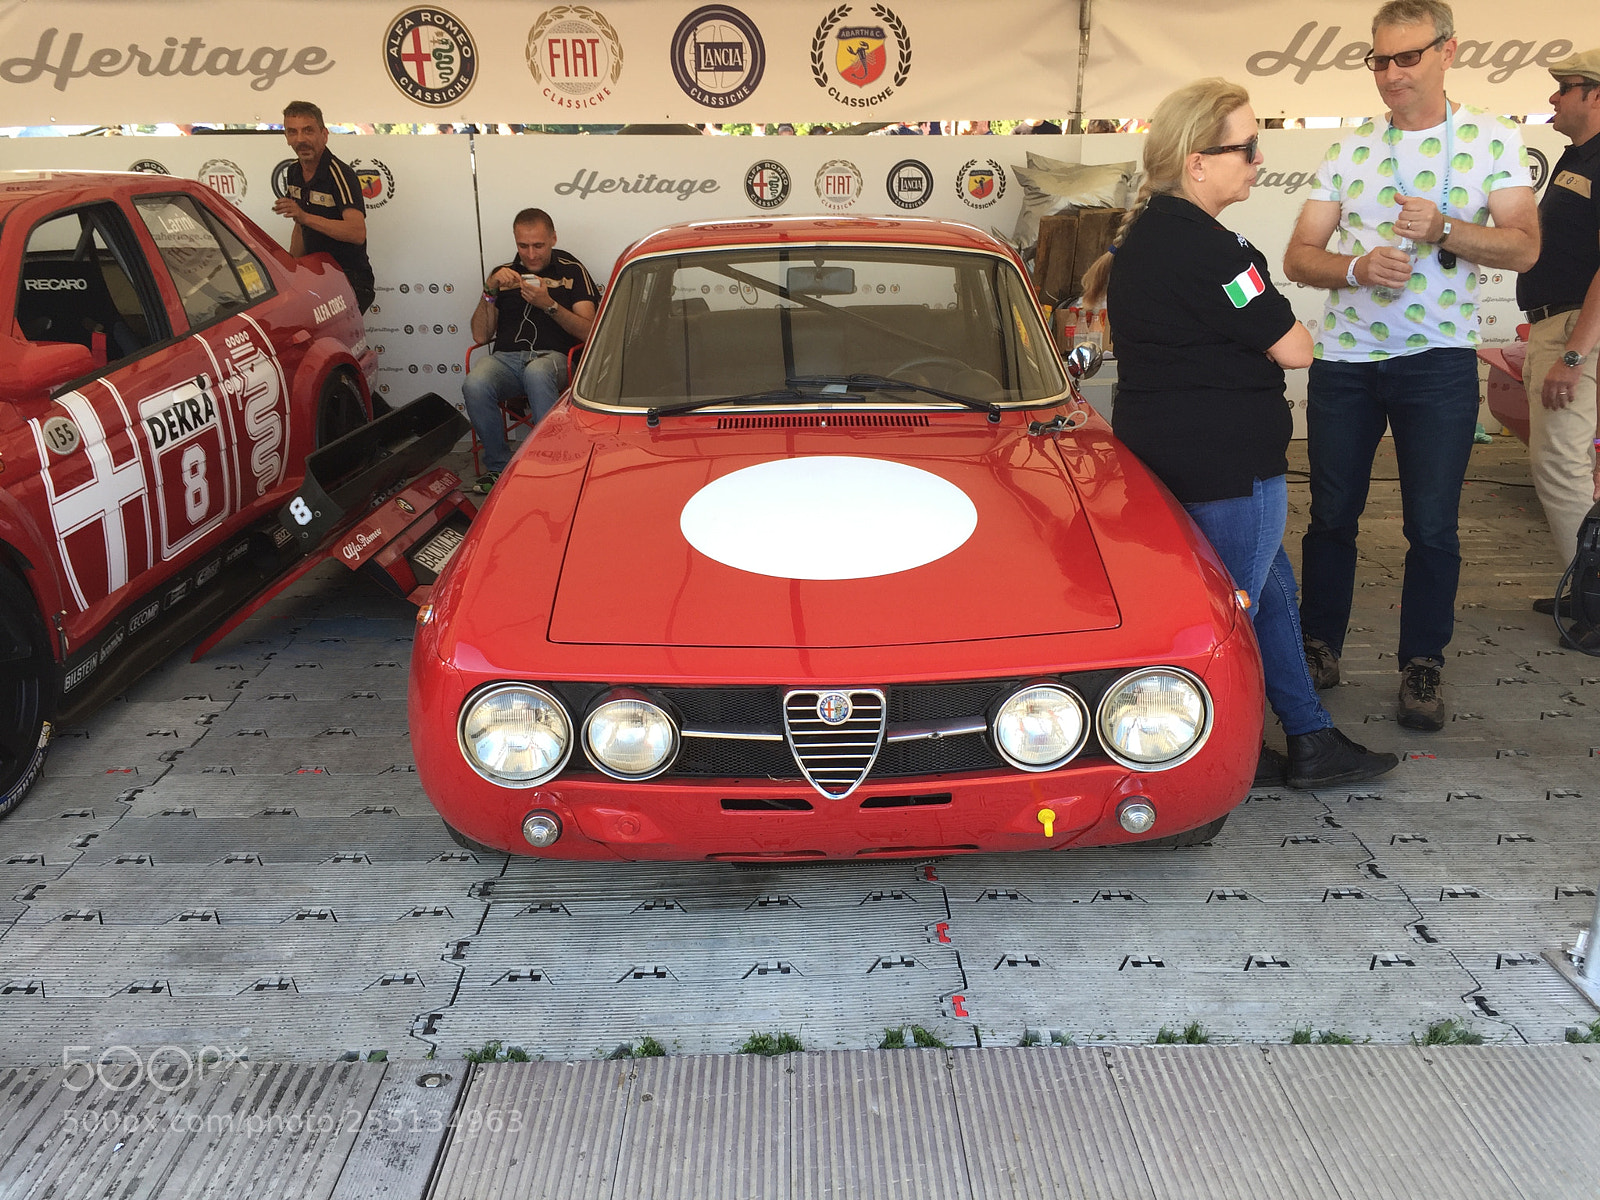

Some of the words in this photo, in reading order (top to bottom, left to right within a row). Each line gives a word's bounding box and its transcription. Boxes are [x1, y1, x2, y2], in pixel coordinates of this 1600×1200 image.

[389, 18, 414, 57] ALFA
[421, 12, 471, 58] ROMEO
[0, 27, 336, 92] Heritage
[548, 38, 599, 77] FIAT
[700, 43, 743, 71] LANCIA
[1246, 21, 1577, 84] Heage
[399, 74, 470, 102] CLASSICHE
[542, 87, 611, 109] CLASSICHE
[690, 85, 750, 106] CLASSICHE
[828, 86, 894, 107] CLASSICHE
[208, 175, 235, 194] FIAT
[554, 168, 721, 201] Heritage
[747, 165, 762, 185] ALFA
[765, 162, 788, 186] ROMEO
[825, 176, 852, 195] FIAT
[901, 178, 922, 192] LANCIA
[963, 199, 997, 209] CLASSICHE
[158, 212, 196, 234] Larini
[24, 279, 88, 290] RECARO
[313, 302, 331, 325] ALFA
[328, 295, 347, 315] CORSE
[146, 392, 216, 449] DEKRA
[48, 423, 74, 449] 155
[181, 443, 209, 526] 8
[289, 496, 313, 526] 8
[342, 542, 361, 560] Alfa
[356, 527, 382, 548] Romeo
[130, 604, 159, 631] CECOMP
[64, 655, 98, 690] BILSTEIN
